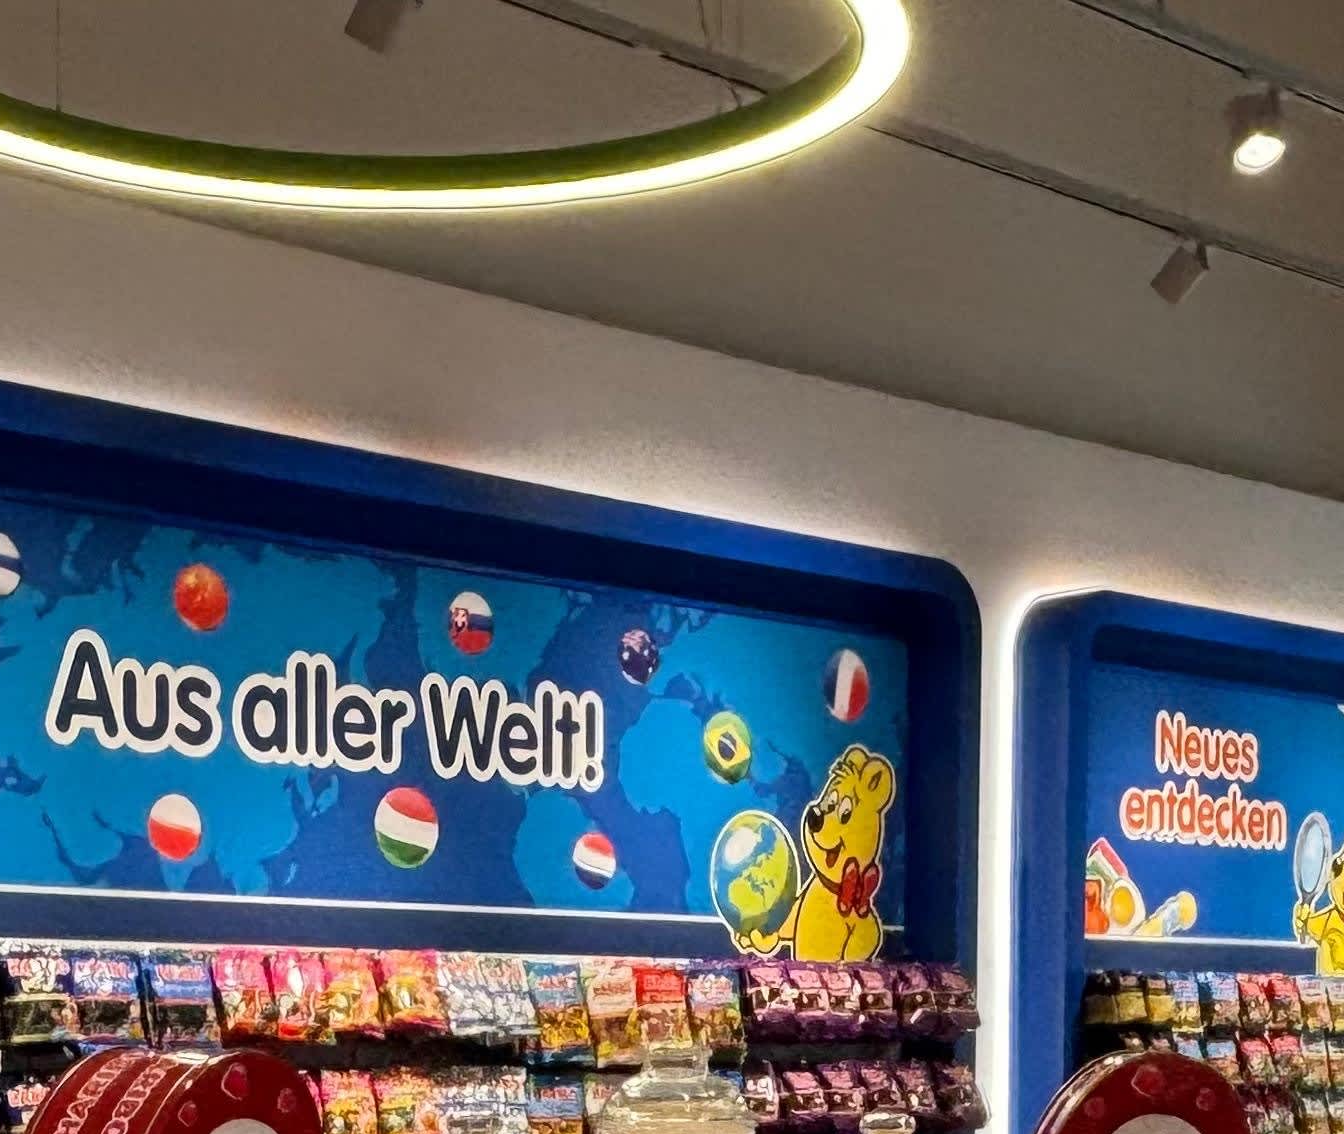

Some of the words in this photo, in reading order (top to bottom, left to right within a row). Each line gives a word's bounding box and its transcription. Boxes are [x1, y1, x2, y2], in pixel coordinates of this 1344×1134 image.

[51, 634, 217, 751] Aus
[236, 656, 412, 769] aller
[424, 679, 602, 790] Welt!
[1158, 713, 1256, 778] Neues
[1122, 780, 1286, 848] entdecken
